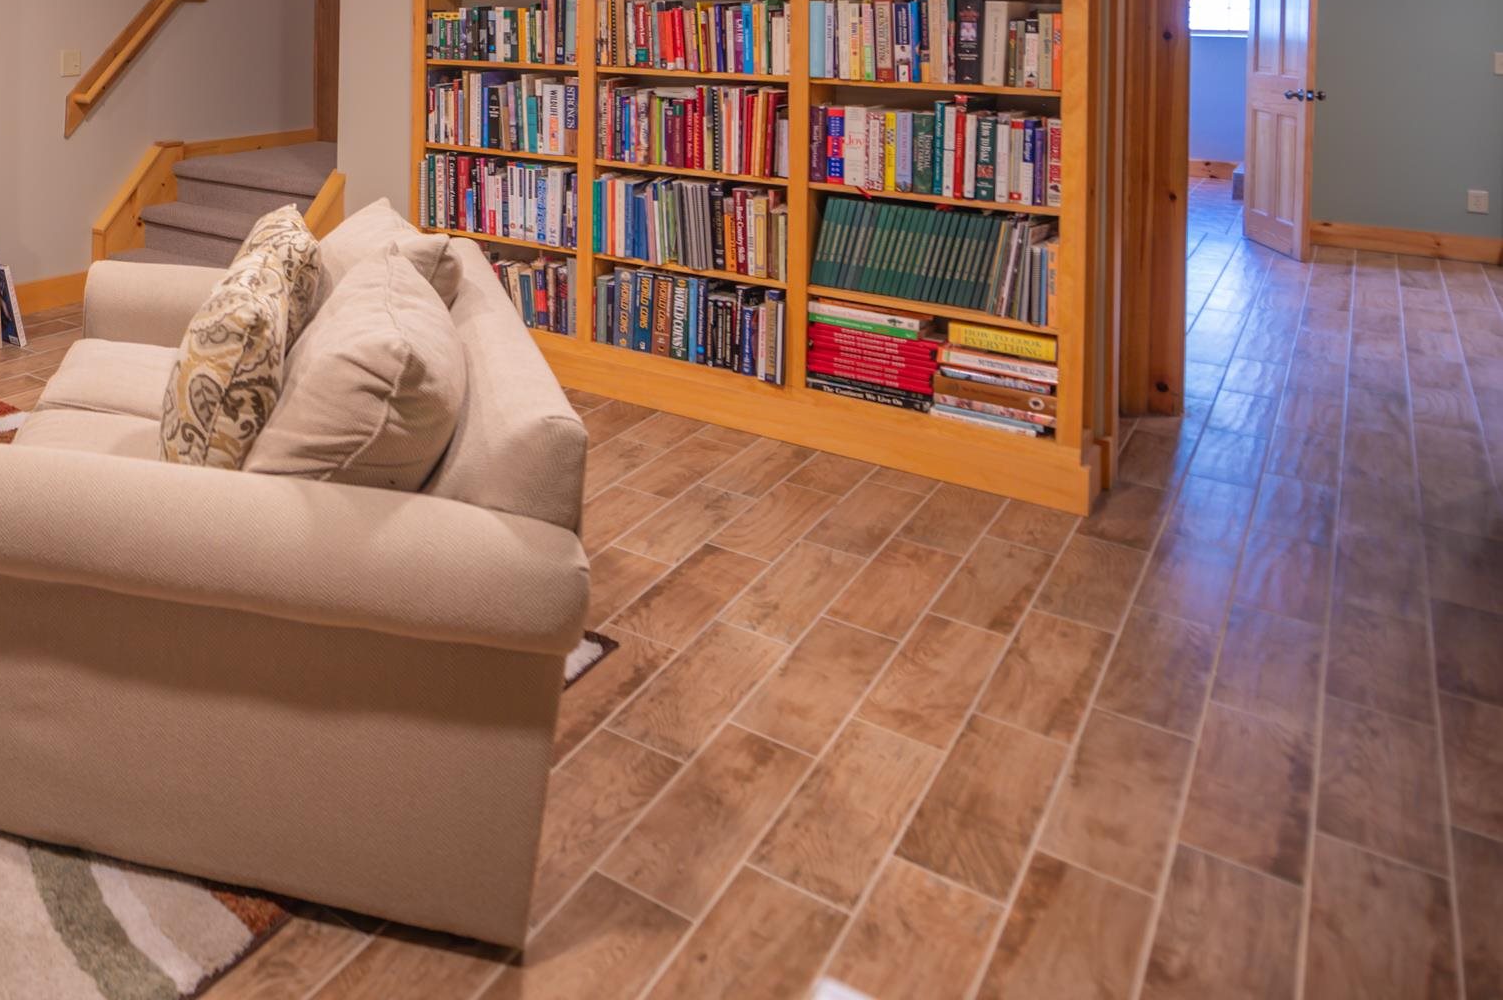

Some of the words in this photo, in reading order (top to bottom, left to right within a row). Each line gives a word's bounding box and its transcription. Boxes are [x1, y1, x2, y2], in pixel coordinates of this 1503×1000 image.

[736, 18, 744, 42] LATIN
[736, 221, 744, 246] Country
[620, 282, 630, 310] WORLD
[641, 277, 650, 305] WORLD
[657, 281, 667, 308] WORLD
[674, 287, 686, 320] WORLD
[619, 311, 629, 334] COINS
[639, 306, 649, 329] COINS
[657, 309, 666, 333] COINS
[672, 320, 684, 348] COINS
[964, 328, 991, 338] HOW
[964, 337, 1042, 356] EVERYTHING
[823, 385, 835, 393] The
[877, 395, 891, 403] Live
